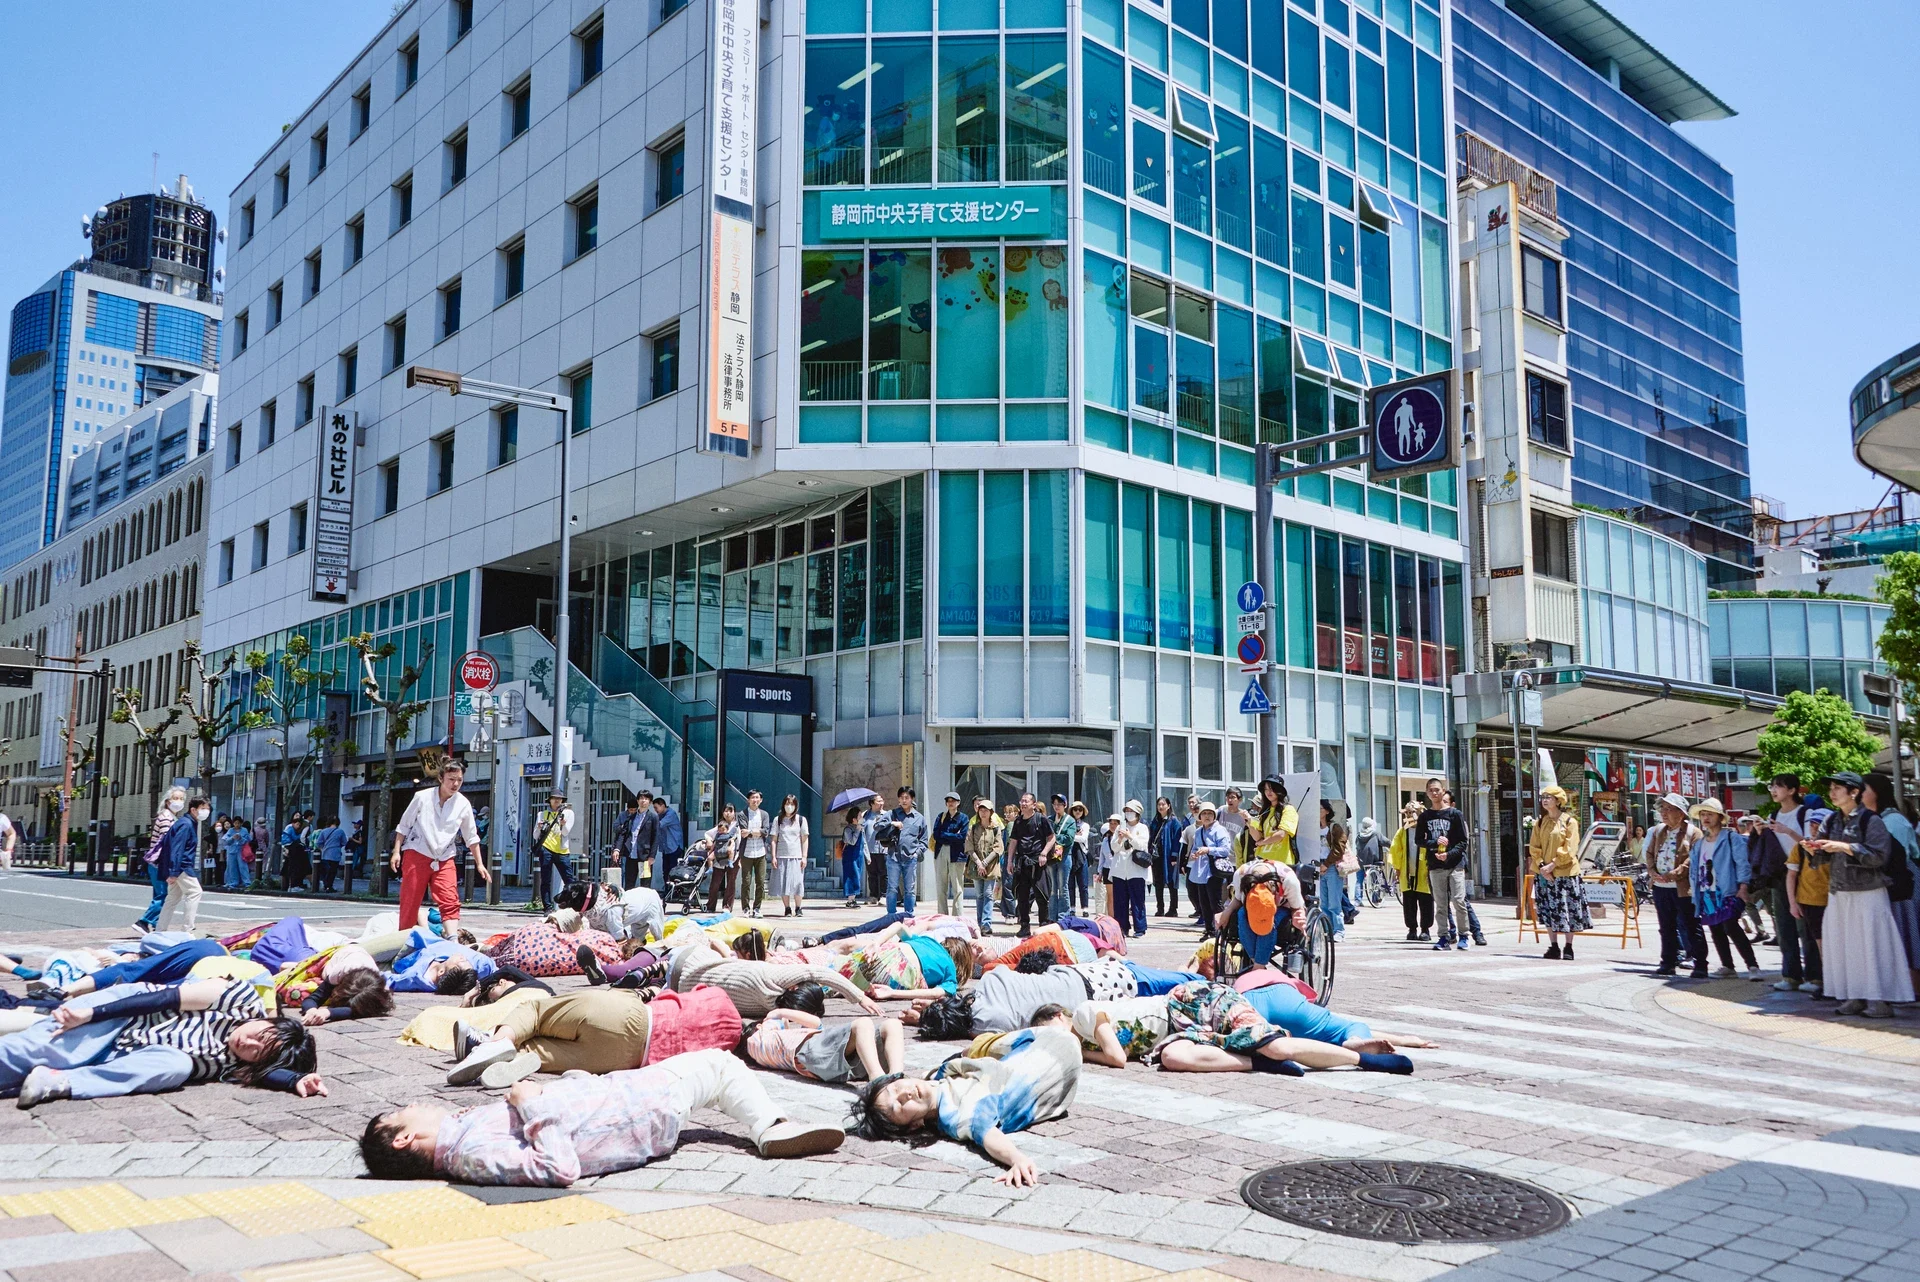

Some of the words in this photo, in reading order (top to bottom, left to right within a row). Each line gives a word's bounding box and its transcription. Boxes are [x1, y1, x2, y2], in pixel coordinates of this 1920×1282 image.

[831, 200, 1040, 226] 静岡市中央子育て支援センター
[723, 353, 733, 411] 法律事務所
[735, 333, 745, 402] 法テラス静岡
[328, 413, 349, 495] 札の辻ビル
[465, 666, 492, 681] 消火栓
[745, 687, 792, 701] m-sports
[527, 742, 552, 759] 美容室
[1645, 764, 1705, 796] スギ薬局
